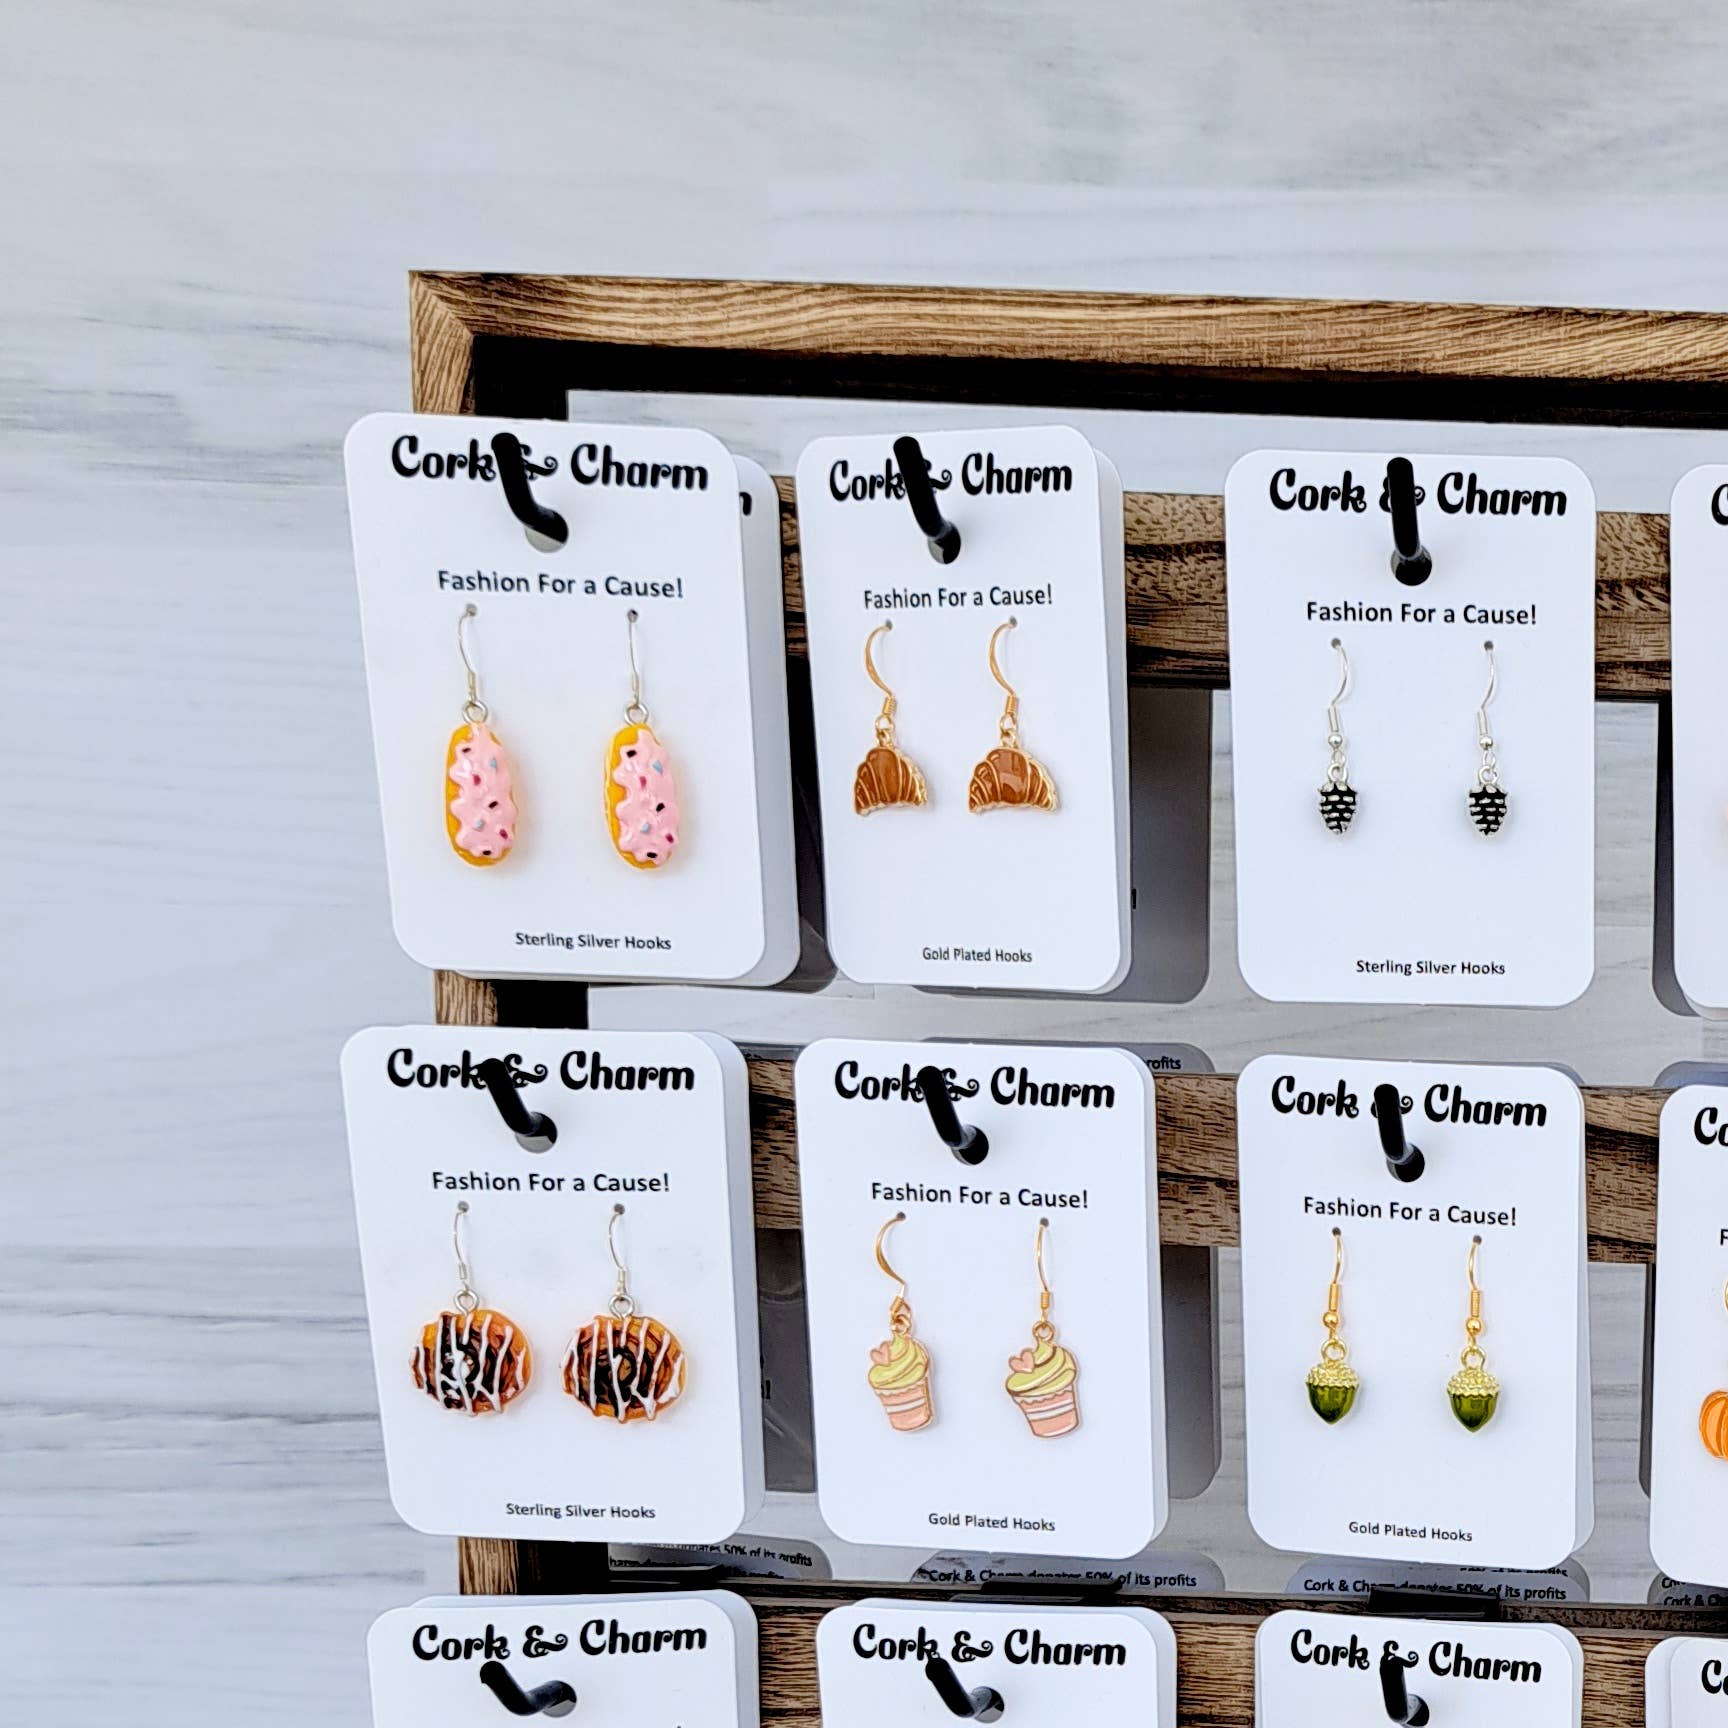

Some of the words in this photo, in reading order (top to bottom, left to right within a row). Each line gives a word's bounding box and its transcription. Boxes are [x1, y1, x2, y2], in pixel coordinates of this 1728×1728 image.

[391, 434, 494, 483] Cork
[570, 443, 709, 491] Charm
[961, 455, 1073, 496] Charm
[1269, 467, 1368, 514] Cork
[1436, 471, 1568, 517] Charm
[438, 570, 530, 593] Fashion
[538, 573, 576, 594] For
[584, 579, 597, 595] a
[604, 575, 683, 598] Cause!
[864, 588, 932, 609] Fashion
[938, 587, 968, 607] For
[973, 591, 984, 606] a
[989, 583, 1053, 606] Cause!
[1307, 600, 1393, 623] Fashion
[1401, 603, 1437, 623] For
[1443, 608, 1455, 624] a
[1463, 604, 1537, 625] Cause!
[515, 932, 574, 950] Sterling
[577, 934, 620, 949] Silver
[624, 936, 672, 950] Hooks
[922, 947, 950, 961] Gold
[953, 948, 992, 962] Plated
[995, 949, 1033, 963] Hooks
[1356, 959, 1413, 977] Sterling
[1416, 960, 1457, 975] Silver
[1461, 961, 1506, 975] Hooks
[559, 1050, 695, 1091] Charm
[990, 1066, 1115, 1109] Charm
[1271, 1075, 1360, 1119] Cork
[1423, 1083, 1547, 1127] Charm
[432, 1170, 521, 1191] Fashion
[528, 1173, 566, 1192] For
[572, 1177, 586, 1192] a
[593, 1172, 670, 1192] Cause!
[871, 1182, 952, 1203] Fashion
[959, 1185, 993, 1205] For
[999, 1191, 1011, 1206] a
[1017, 1188, 1088, 1209] Cause!
[1304, 1196, 1382, 1219] Fashion
[1389, 1201, 1423, 1221] For
[1428, 1208, 1440, 1222] a
[1447, 1205, 1516, 1227] Cause!
[506, 1502, 562, 1520] Sterling
[565, 1504, 606, 1518] Silver
[610, 1506, 656, 1519] Hooks
[928, 1512, 961, 1526] Gold
[965, 1515, 1008, 1529] Plated
[1012, 1517, 1056, 1532] Hooks
[1348, 1521, 1380, 1535] Gold
[1384, 1524, 1427, 1539] Plated
[1431, 1528, 1473, 1542] Hooks
[1135, 1574, 1151, 1586] its
[1154, 1574, 1197, 1589] profits
[1505, 1585, 1521, 1599] its
[1523, 1586, 1567, 1601] profits
[412, 1623, 511, 1664] Cork
[522, 1624, 569, 1659] &
[579, 1618, 708, 1656] Charm
[852, 1623, 945, 1663] Cork
[950, 1630, 994, 1663] &
[1003, 1628, 1127, 1666] Charm
[1290, 1628, 1371, 1671] Cork
[1428, 1641, 1542, 1683] Charm
